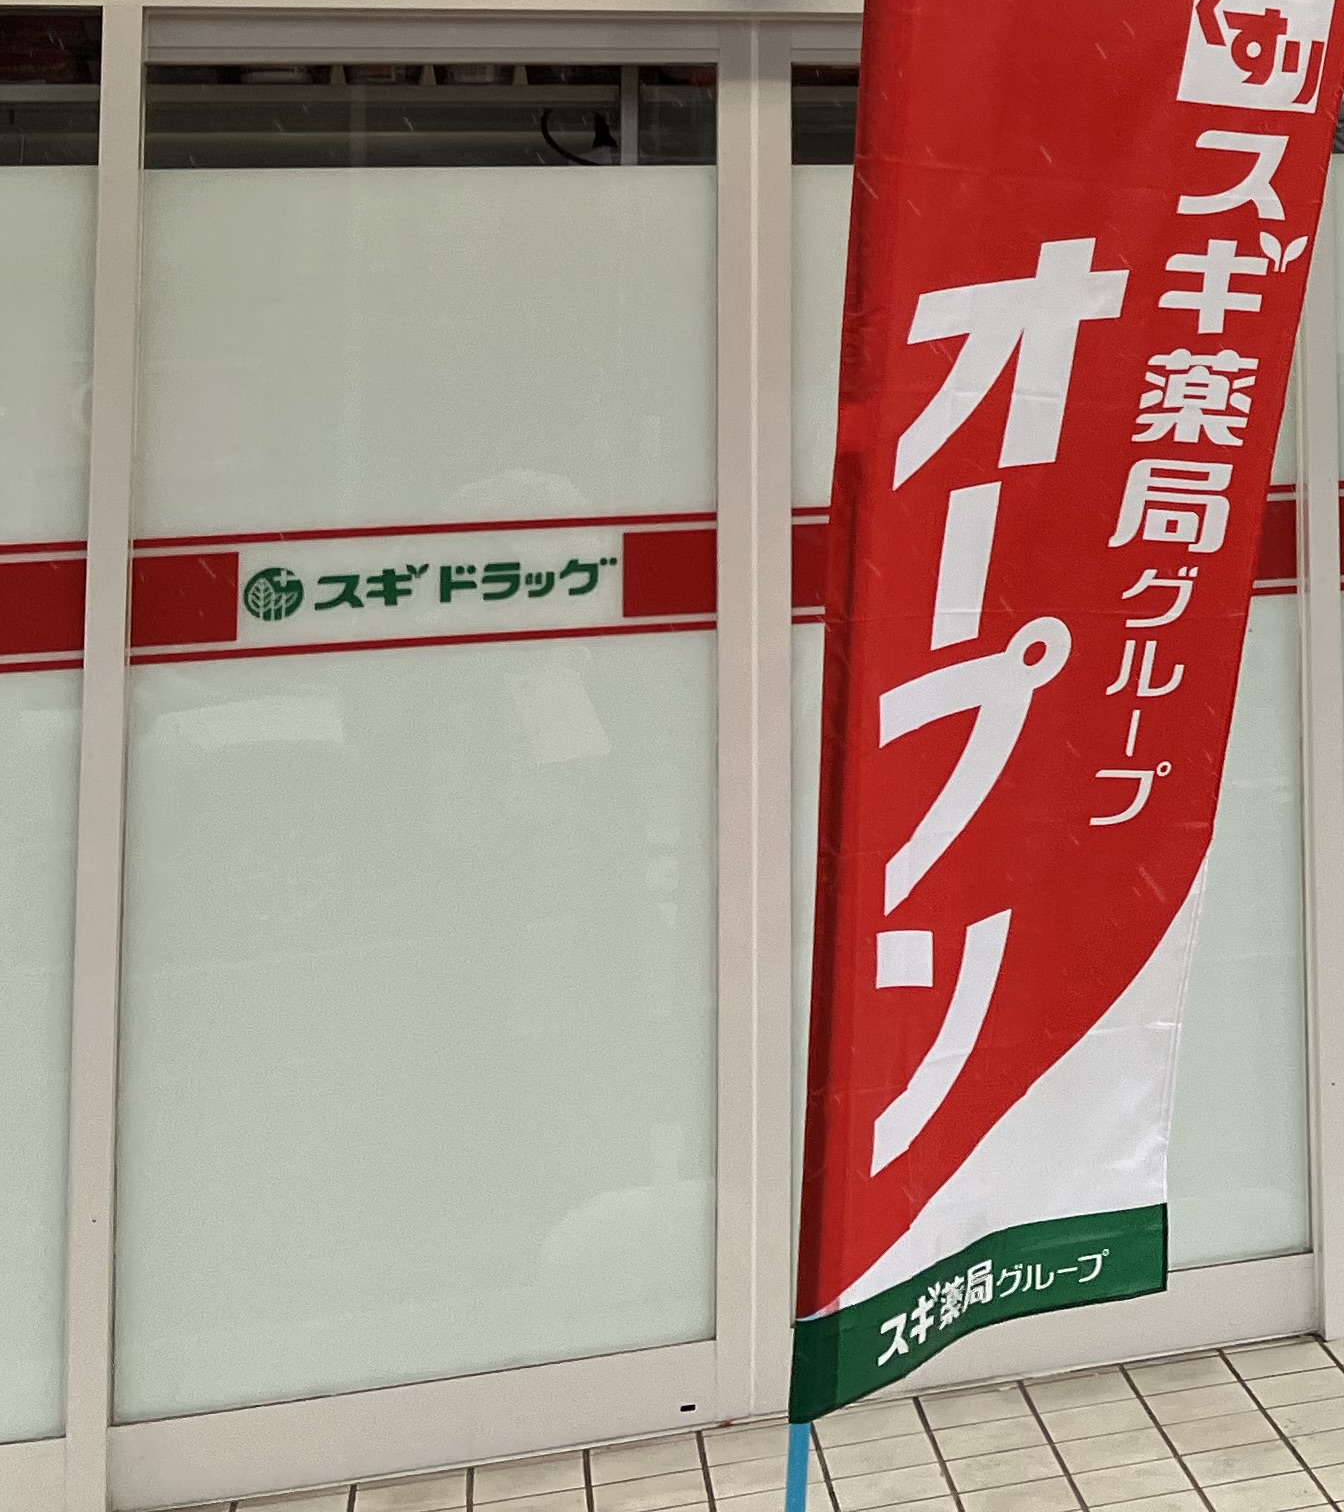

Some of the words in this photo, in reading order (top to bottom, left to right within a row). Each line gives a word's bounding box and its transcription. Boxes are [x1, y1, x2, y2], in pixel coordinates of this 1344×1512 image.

[870, 237, 1130, 1178] オープン
[1089, 130, 1309, 827] スギ薬局グループ
[877, 1248, 1110, 1368] スギ薬局グループ
